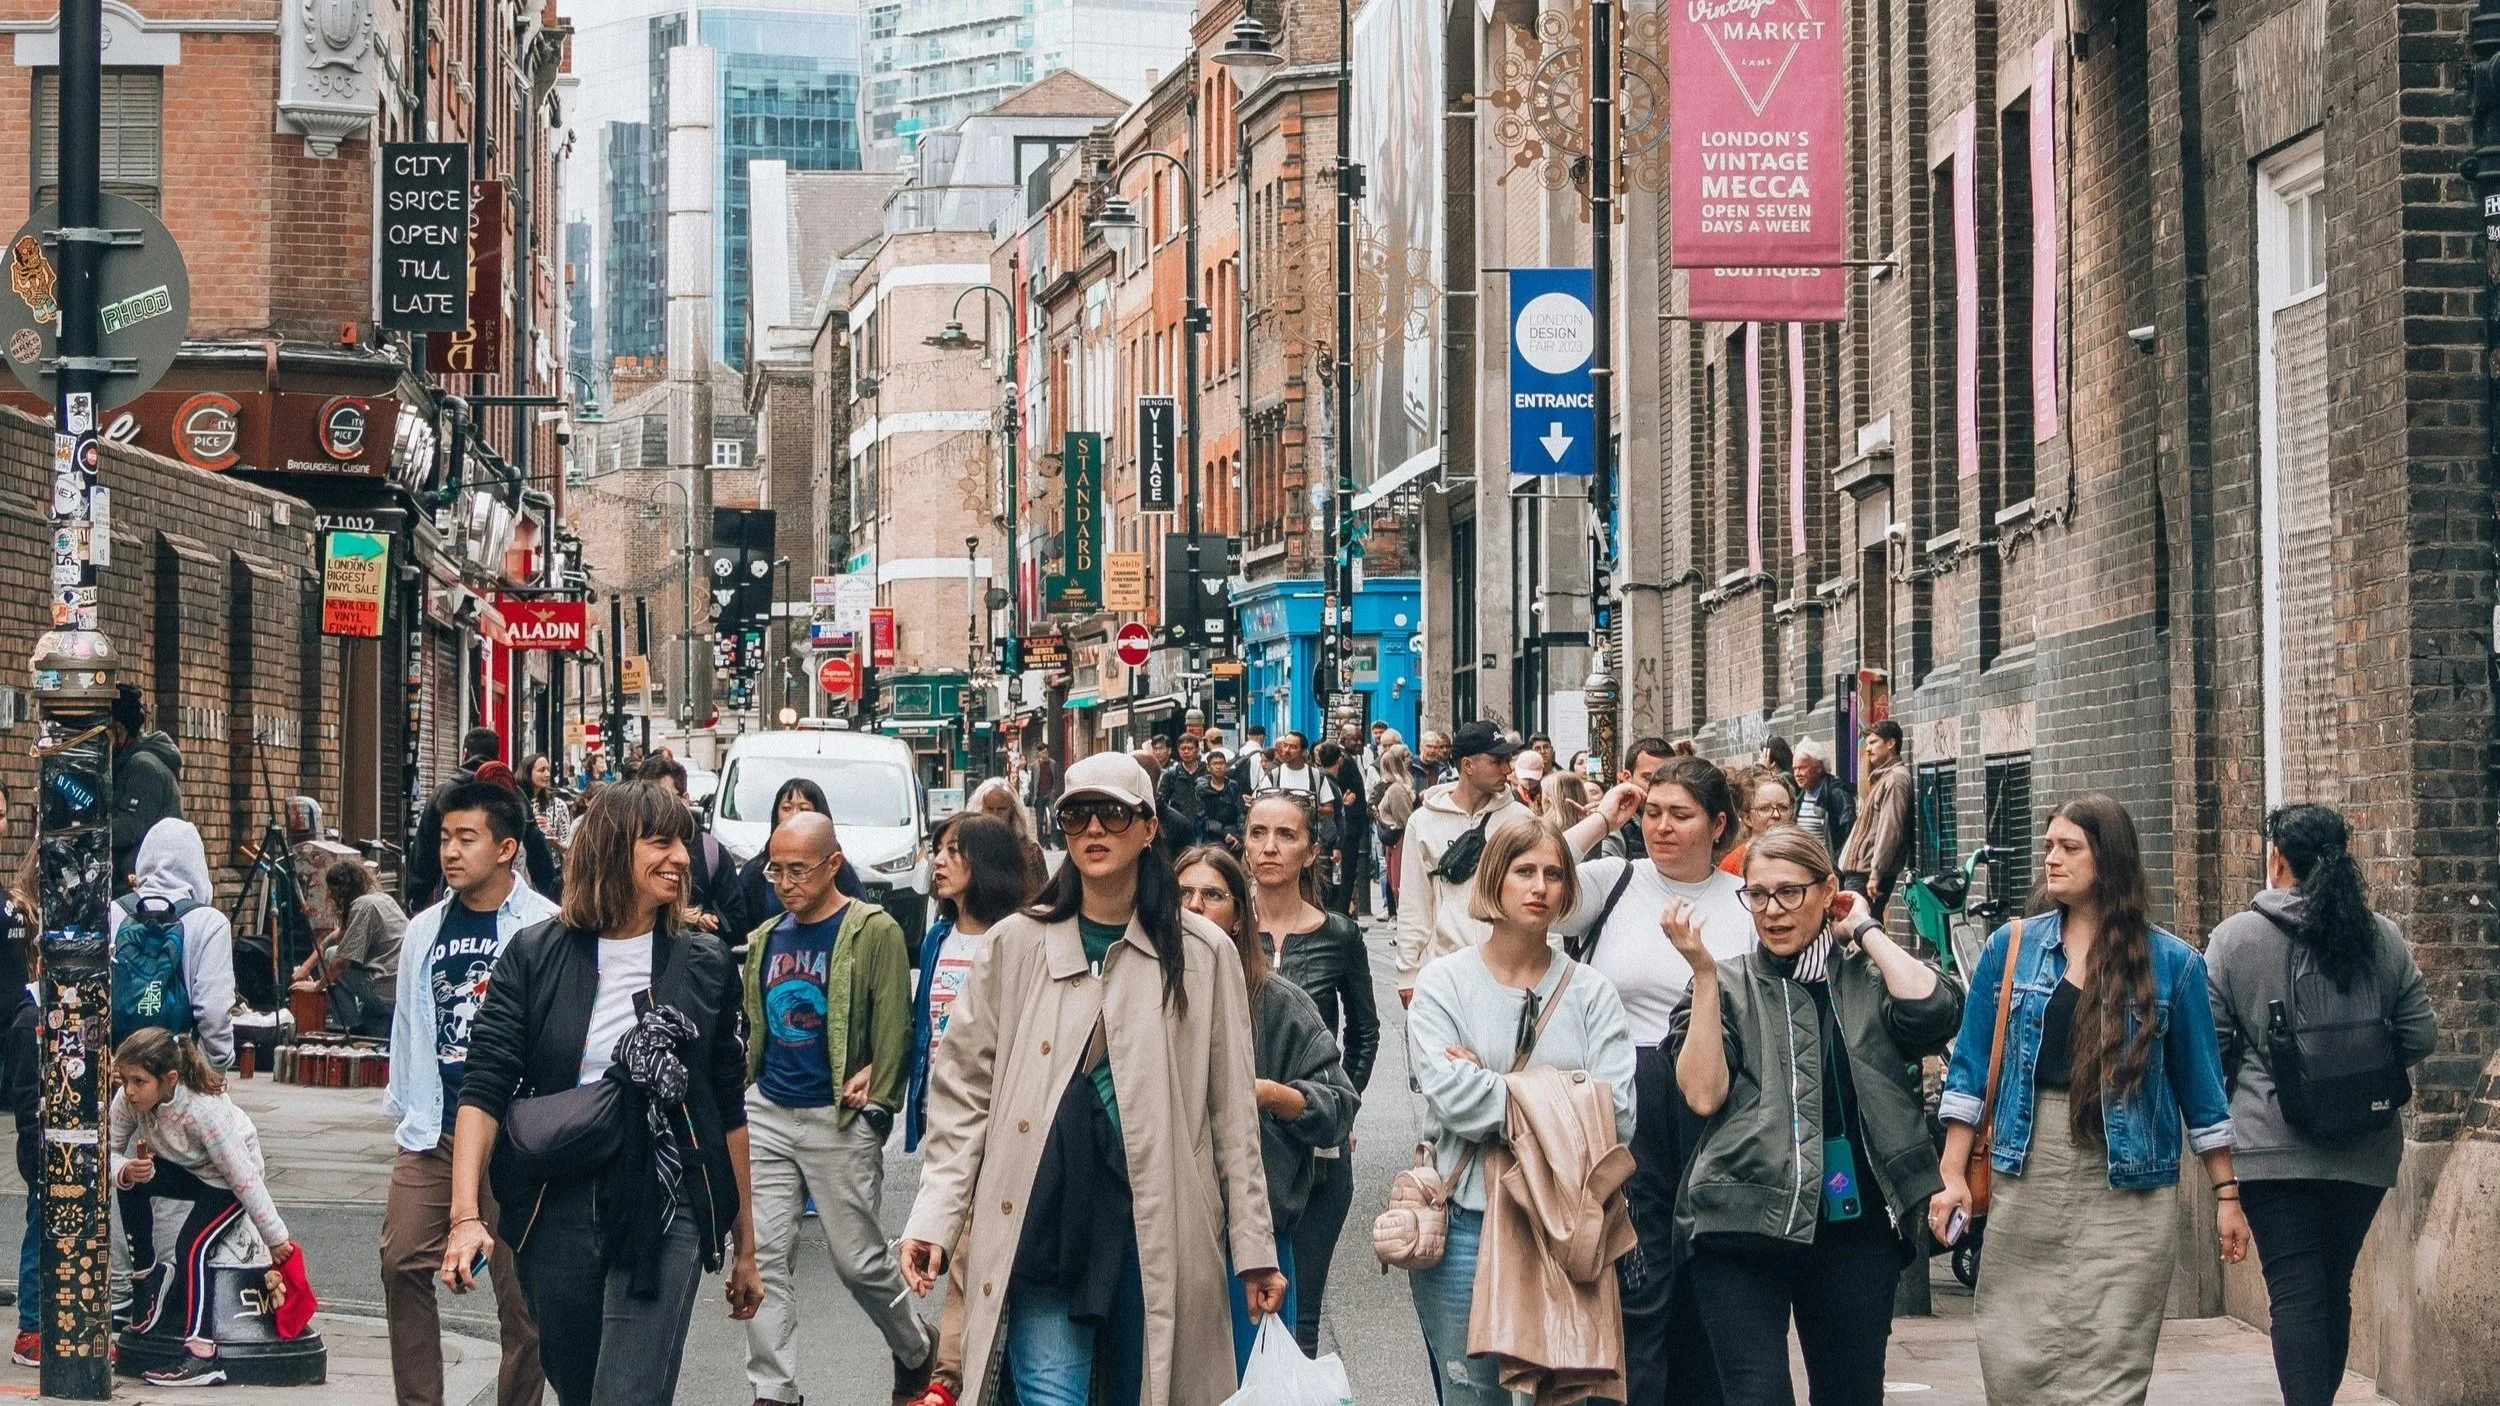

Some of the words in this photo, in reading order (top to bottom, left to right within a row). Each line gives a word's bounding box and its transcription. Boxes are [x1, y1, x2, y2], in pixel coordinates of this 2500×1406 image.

[1723, 21, 1826, 40] MARKET
[1741, 58, 1773, 67] LANE
[312, 74, 354, 97] 1903
[1701, 131, 1809, 147] LONDON'S
[395, 155, 452, 177] CITY
[1702, 152, 1809, 171] VINTAGE
[1701, 176, 1810, 198] MECCA
[389, 190, 461, 212] SPICE
[1701, 204, 1750, 218] OPEN
[1756, 204, 1811, 218] SEVEN
[1701, 220, 1743, 234] DAYS
[1748, 220, 1760, 233] A
[1765, 220, 1811, 233] WEEK
[389, 225, 459, 246] OPEN
[397, 259, 450, 281] TILL
[1713, 267, 1821, 278] BOUTIQUES
[103, 290, 171, 332] PHOOD
[393, 294, 454, 315] LATE
[1529, 313, 1583, 326] LONDON
[1529, 327, 1577, 339] DESIGN
[1529, 341, 1554, 353] FAIR
[1558, 341, 1583, 353] 2023
[1140, 399, 1173, 407] BENGAL
[1515, 394, 1594, 408] ENTRANCE
[1149, 408, 1163, 502] VILLAGE
[287, 459, 340, 473] BANGLADESHI
[1076, 438, 1092, 571] STANDARD
[327, 571, 366, 583] BIGGEST
[327, 581, 352, 593] VINYL
[355, 584, 379, 595] SALE
[334, 611, 362, 623] VINYL
[508, 622, 580, 640] ALADIN
[621, 671, 641, 679] OTICE
